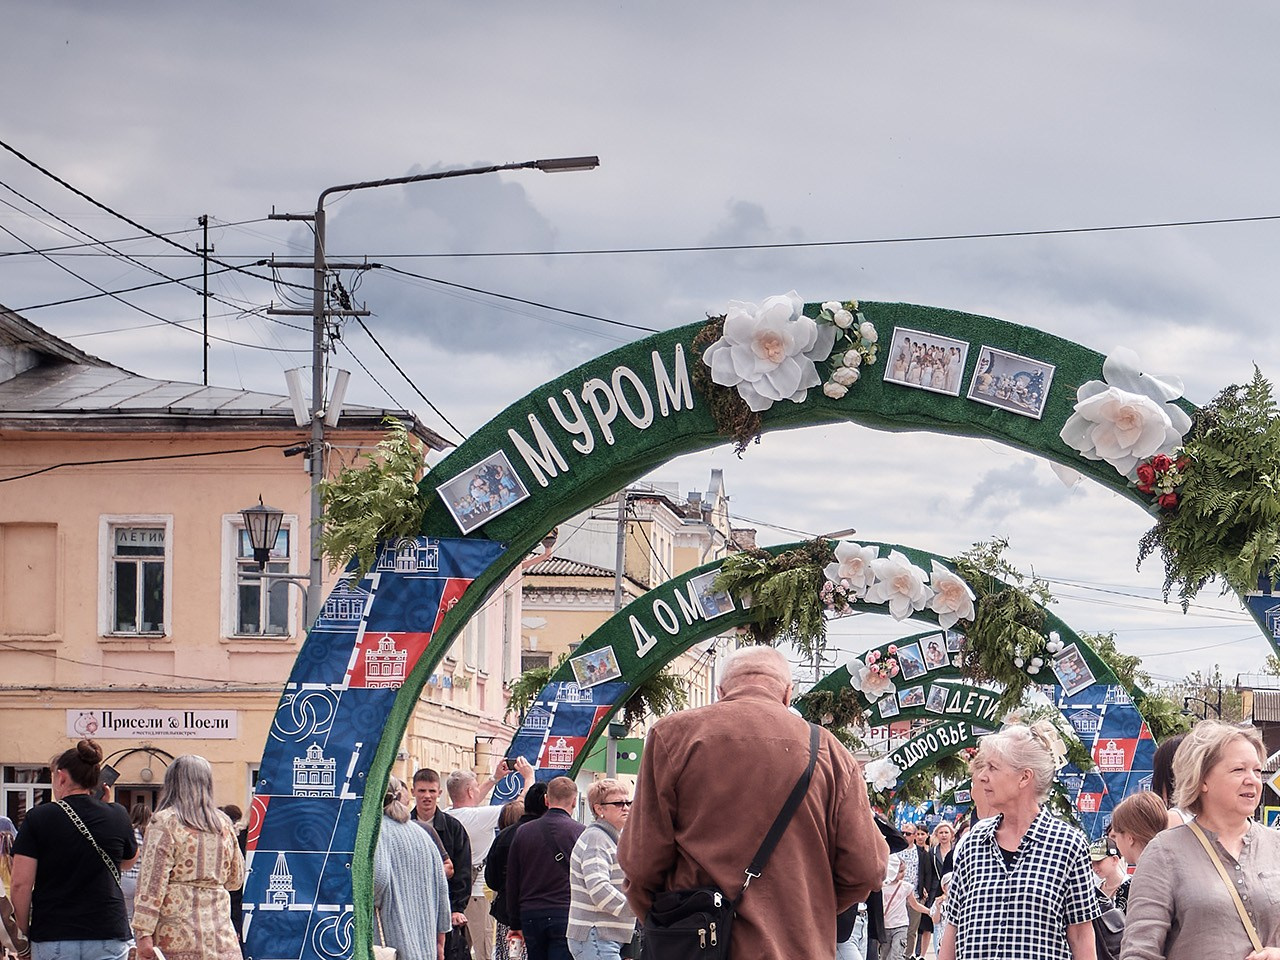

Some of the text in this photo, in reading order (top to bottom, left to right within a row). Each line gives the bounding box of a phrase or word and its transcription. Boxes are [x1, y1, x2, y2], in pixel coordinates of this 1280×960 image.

[507, 342, 694, 488] МУРОМ
[629, 581, 704, 658] ДОМ
[102, 711, 229, 731] Присели & Поели
[945, 690, 1001, 722] ДЕТИ
